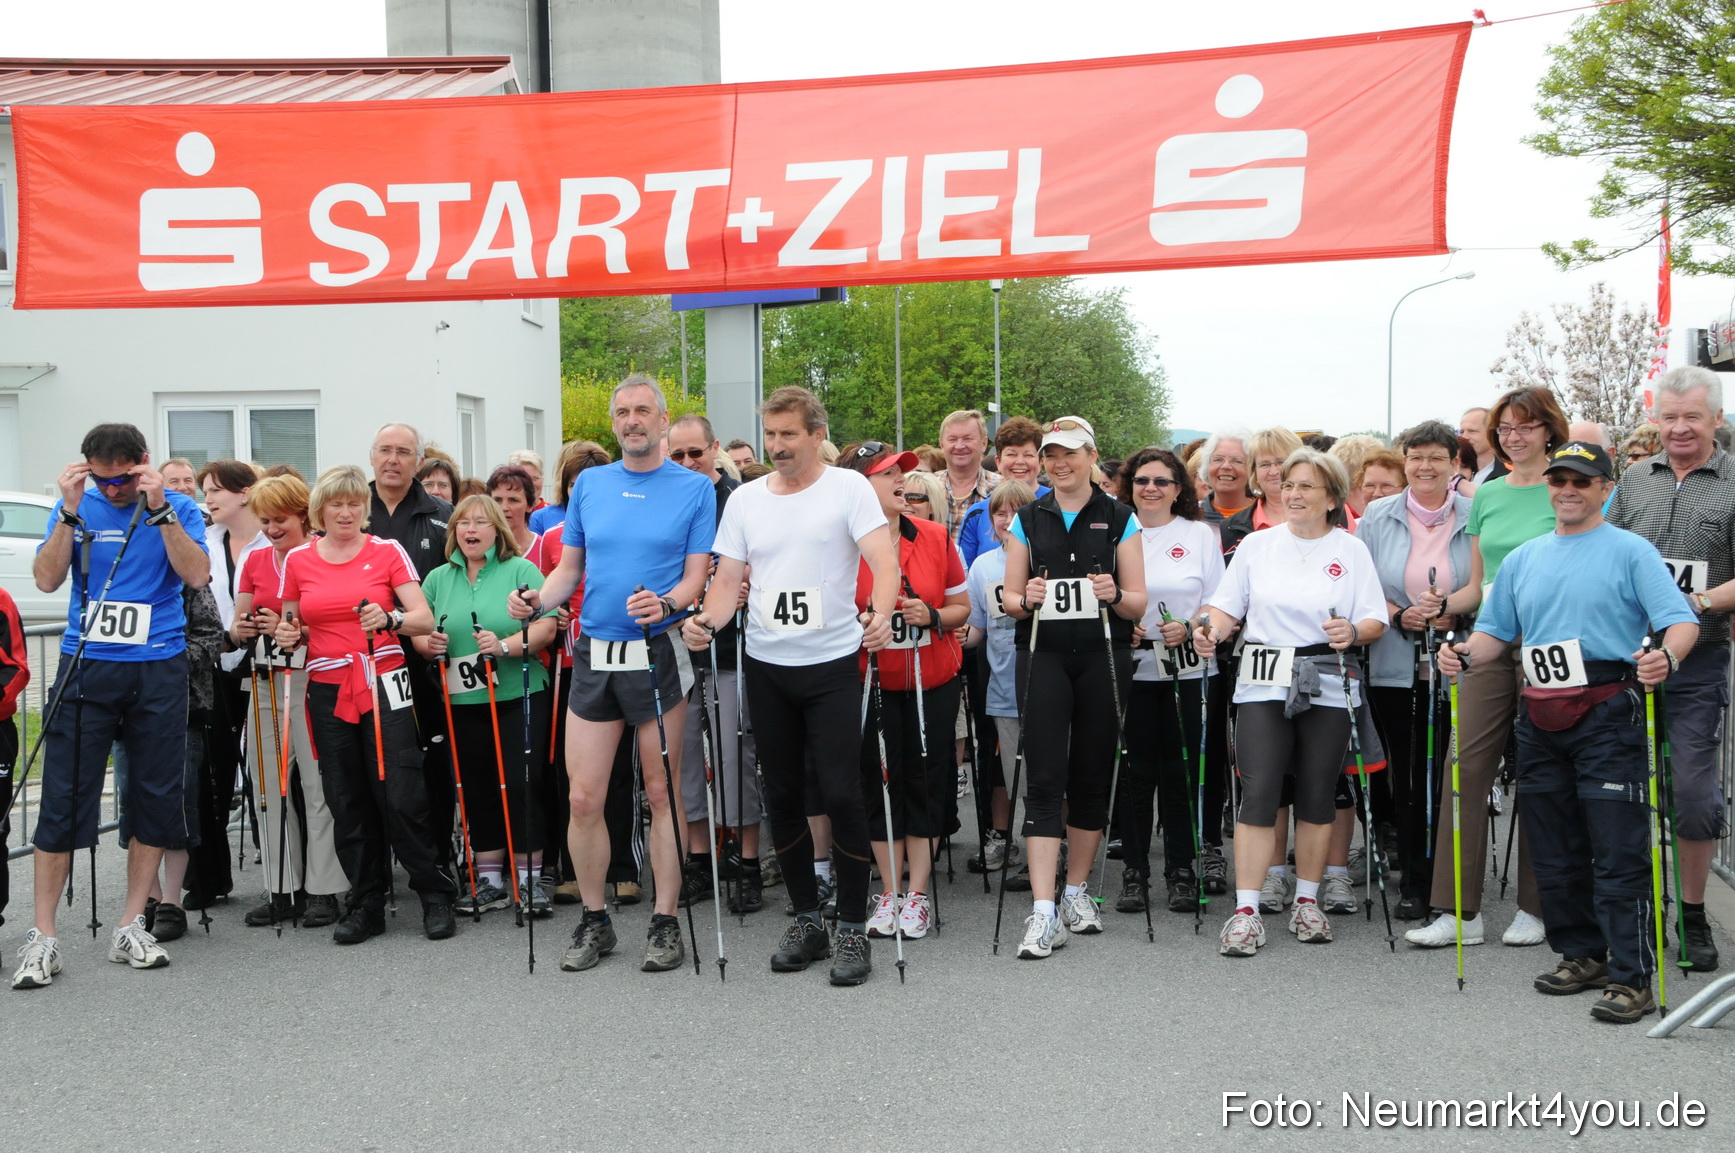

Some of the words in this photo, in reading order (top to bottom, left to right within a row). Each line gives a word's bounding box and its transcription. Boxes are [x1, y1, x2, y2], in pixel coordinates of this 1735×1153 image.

[773, 591, 809, 626] 45
[1055, 580, 1083, 613] 91
[100, 604, 139, 639] 50
[1251, 648, 1281, 681] 117
[1531, 644, 1571, 684] 89
